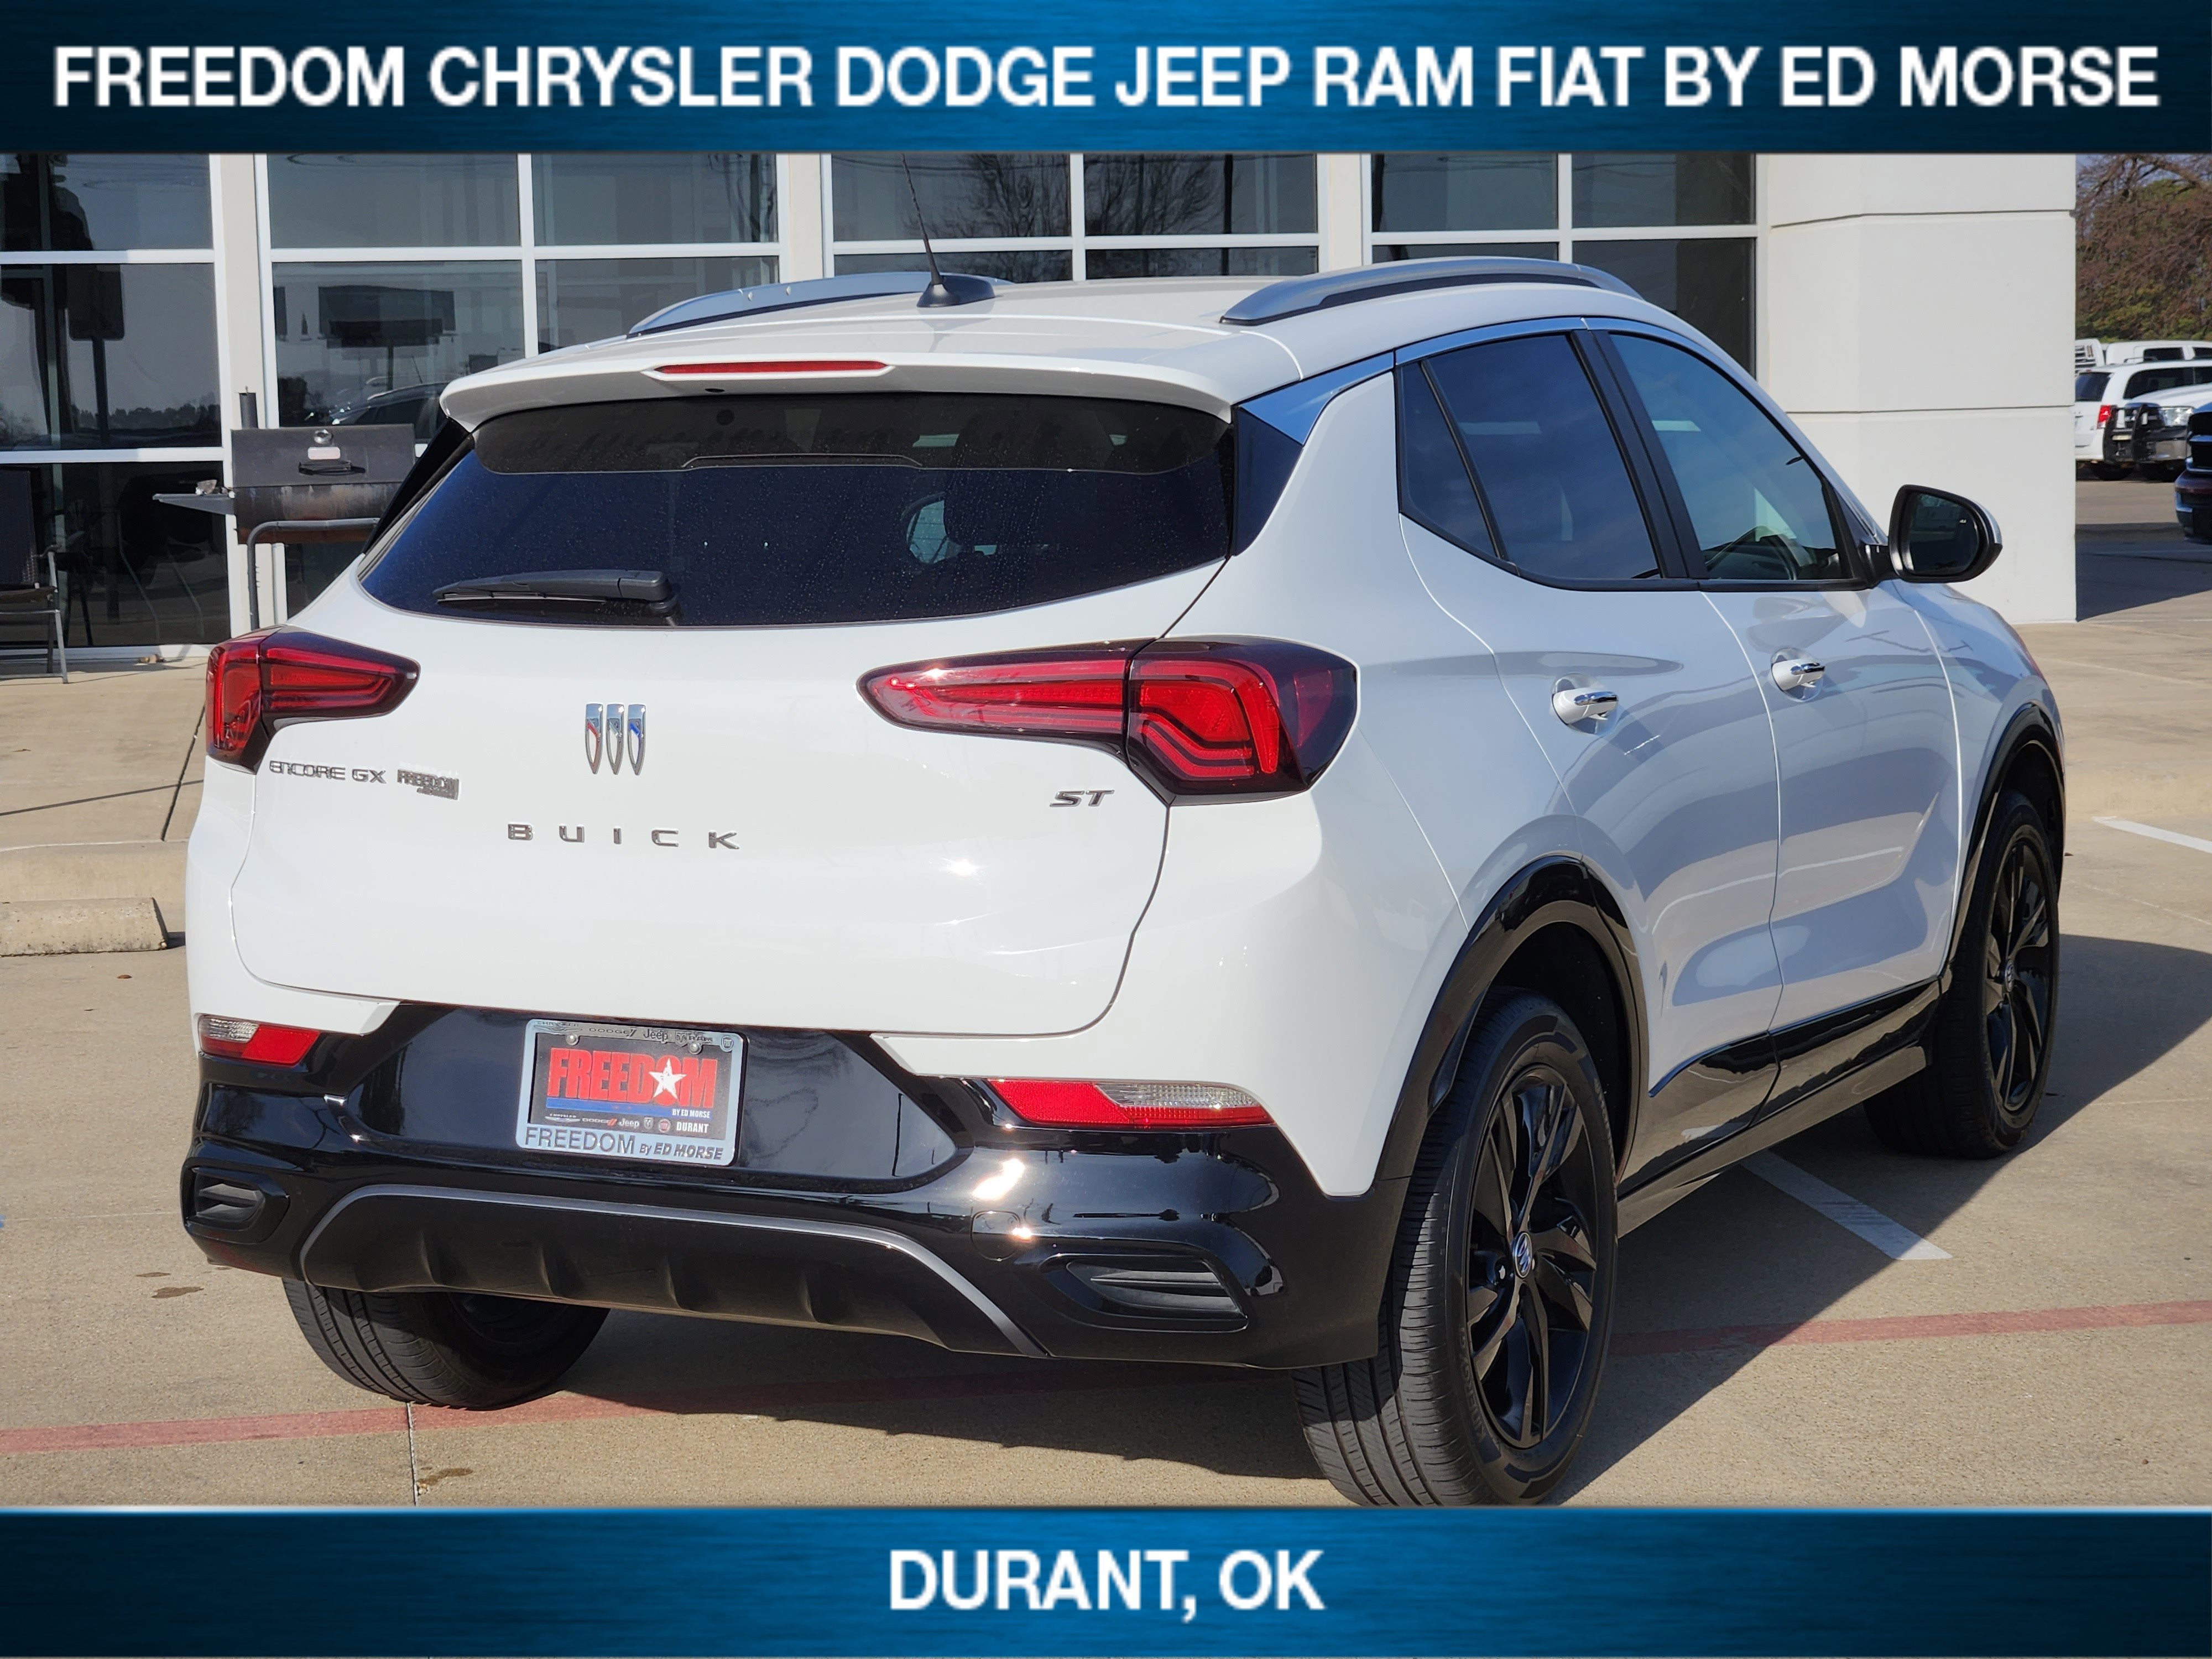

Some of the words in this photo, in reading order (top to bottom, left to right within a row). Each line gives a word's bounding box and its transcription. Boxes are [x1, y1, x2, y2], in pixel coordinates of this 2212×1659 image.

[269, 760, 346, 781] ENCORE
[352, 768, 387, 784] GX
[1049, 789, 1115, 807] ST
[507, 823, 741, 850] BUICK
[643, 1029, 669, 1042] Jeep
[689, 1110, 711, 1118] MORSE
[619, 1118, 640, 1129] Jeep
[676, 1121, 709, 1133] DURANT
[525, 1126, 635, 1155] FREEDOM
[654, 1142, 672, 1155] ED
[674, 1144, 724, 1160] MORSE
